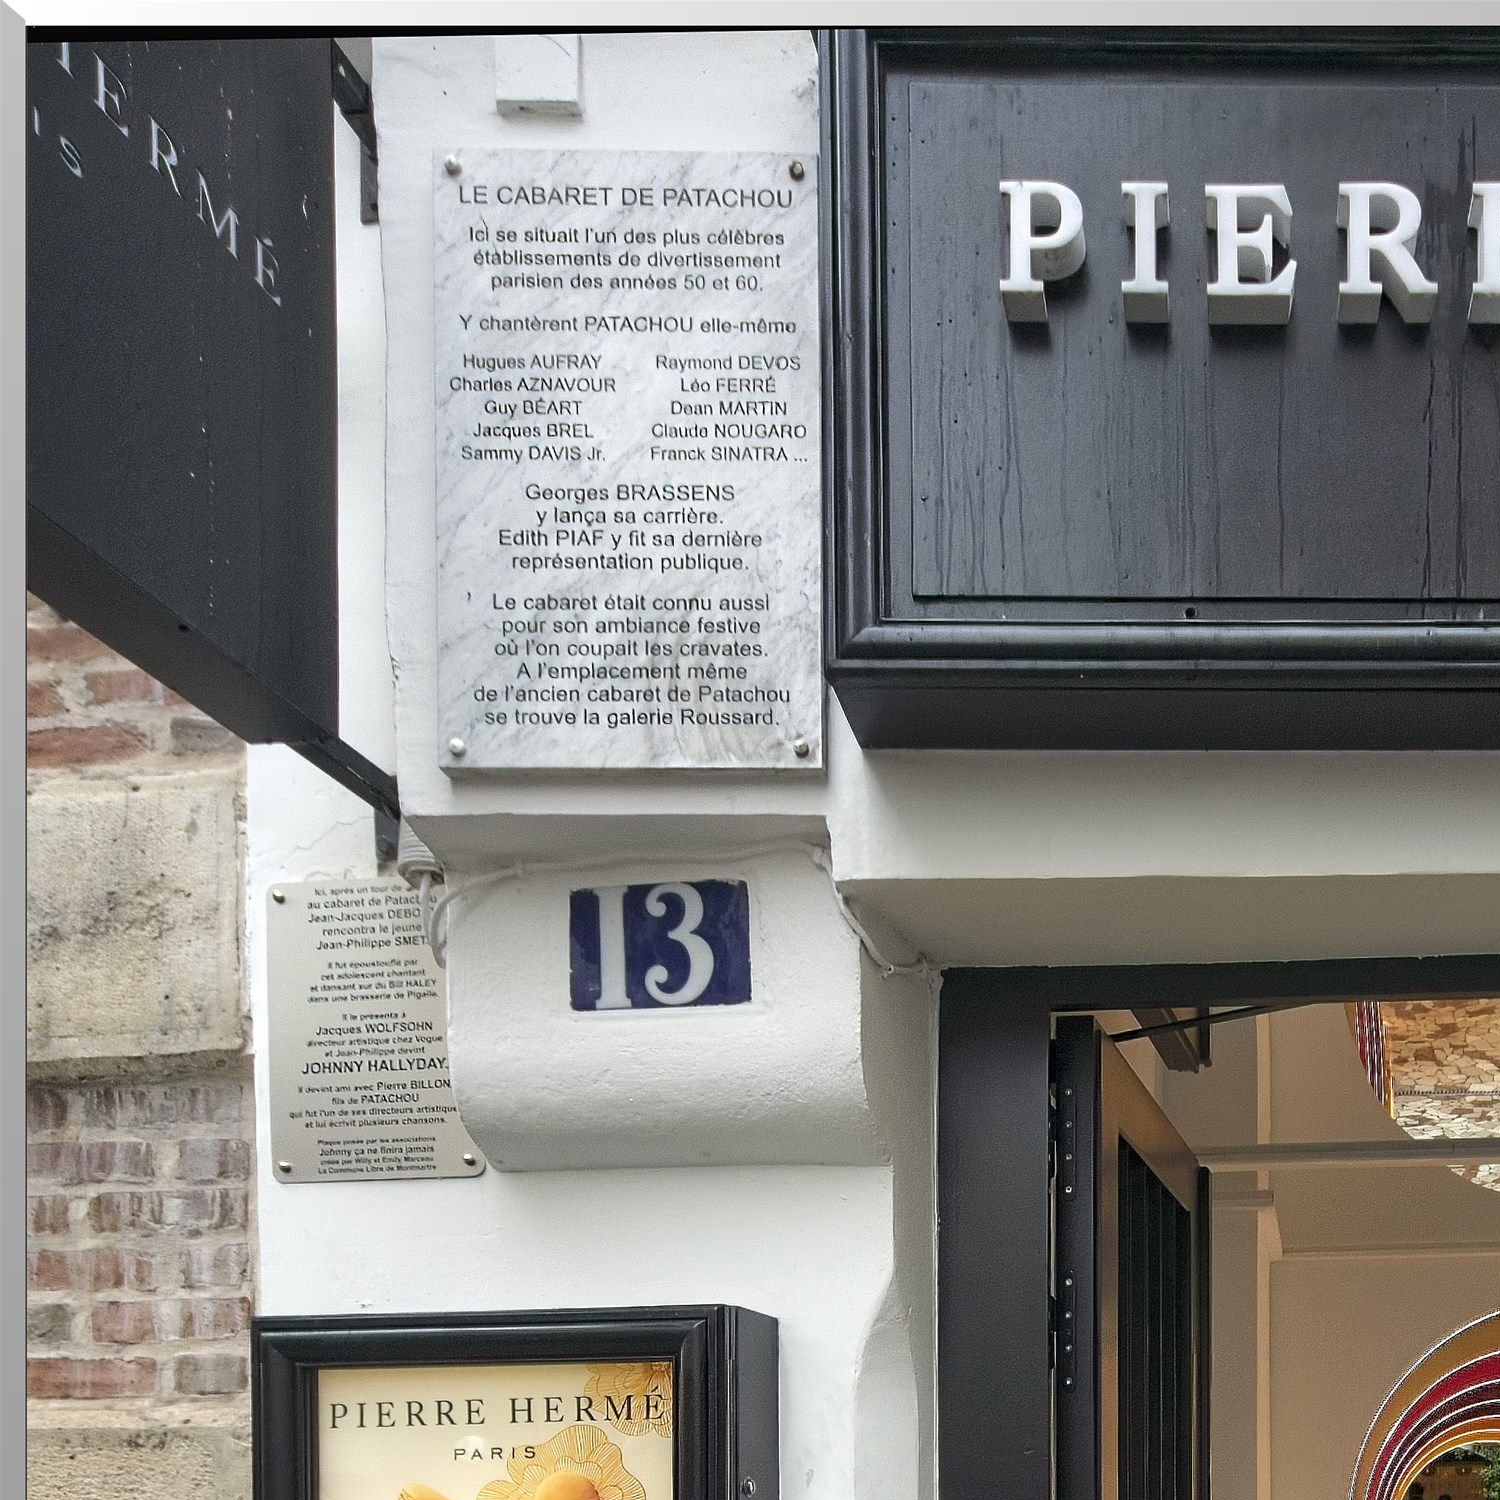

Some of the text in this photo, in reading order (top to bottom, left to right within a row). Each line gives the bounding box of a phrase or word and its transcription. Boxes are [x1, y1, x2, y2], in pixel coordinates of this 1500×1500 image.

[459, 186, 793, 208] LE CABARET DE PATACHOU
[469, 227, 784, 248] Ici se situait l'un des plus célèbres
[473, 250, 780, 269] établissements de divertissement
[491, 274, 763, 292] parisien des années 50 et 60.
[459, 315, 796, 334] Y chantèrent PATACHOU elle-même
[463, 354, 601, 375] Hugues AUFRAY
[656, 355, 800, 374] Raymond DEVOS
[450, 378, 616, 392] Charles AZNAVOUR
[680, 376, 776, 393] Léo FERRÉ
[484, 398, 582, 419] Guy BÉART
[671, 401, 787, 416] Dean MARTIN
[473, 423, 593, 441] Jacques BREL
[652, 424, 806, 439] Claude NOUGARO
[461, 446, 606, 465] Sammy DAVIS Jr.
[650, 447, 788, 462] Franck SINATRA
[526, 484, 735, 504] Georges BRASSENS
[536, 509, 723, 528] y lança sa carrière.
[499, 530, 762, 551] Edith PIAF y fit sa dernière
[512, 553, 748, 574] représentation publique.
[493, 594, 769, 611] Le cabaret était connu aussi
[502, 617, 761, 637] pour son ambiance festive
[495, 640, 768, 661] où l'on coupait les cravates.
[517, 663, 747, 684] A l'emplacement même
[474, 686, 790, 703] de l'ancien cabaret de Patachou
[484, 709, 780, 728] se trouve la galerie Roussard.
[308, 911, 385, 923] Jean-Jacques
[316, 937, 391, 950] Jean-Philippe
[593, 882, 714, 1009] 13
[316, 1021, 433, 1036] Jacques WOLFSOHN
[302, 1061, 363, 1074] JOHNNY
[376, 1081, 407, 1090] Pierre
[361, 1094, 419, 1104] PATACHOU
[330, 1386, 668, 1429] PIERRE HERMÉ
[454, 1446, 536, 1461] PARIS
